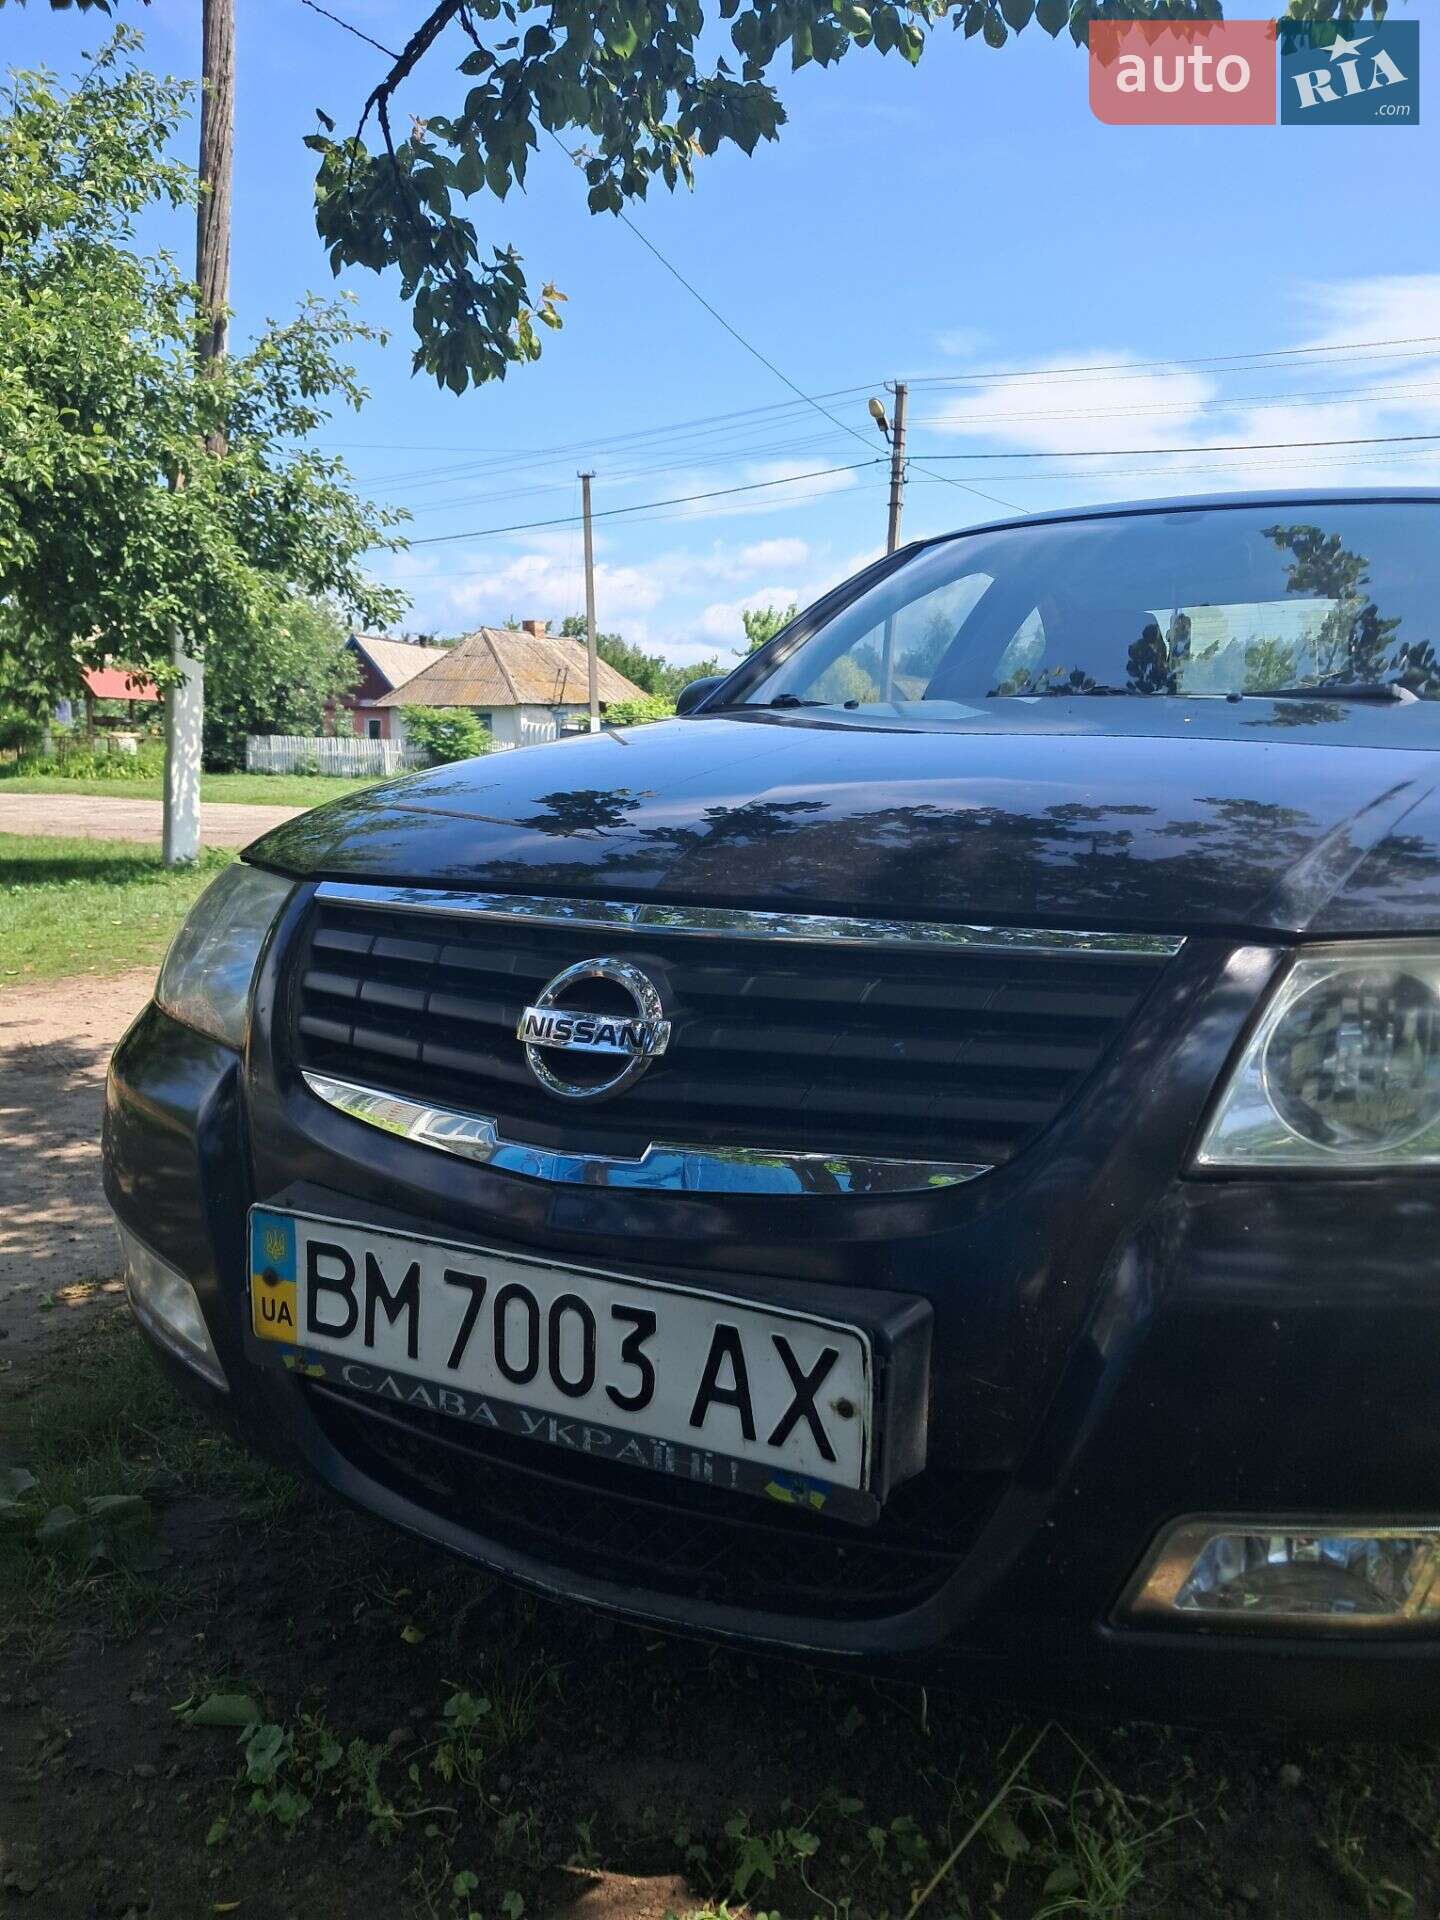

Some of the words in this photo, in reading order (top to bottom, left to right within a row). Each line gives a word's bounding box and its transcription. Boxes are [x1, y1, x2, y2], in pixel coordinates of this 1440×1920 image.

[525, 1015, 647, 1048] NISSAN
[261, 1296, 293, 1328] UA
[443, 1267, 657, 1413] 7003
[689, 1323, 840, 1463] AX
[341, 1365, 499, 1427] СЛАВА
